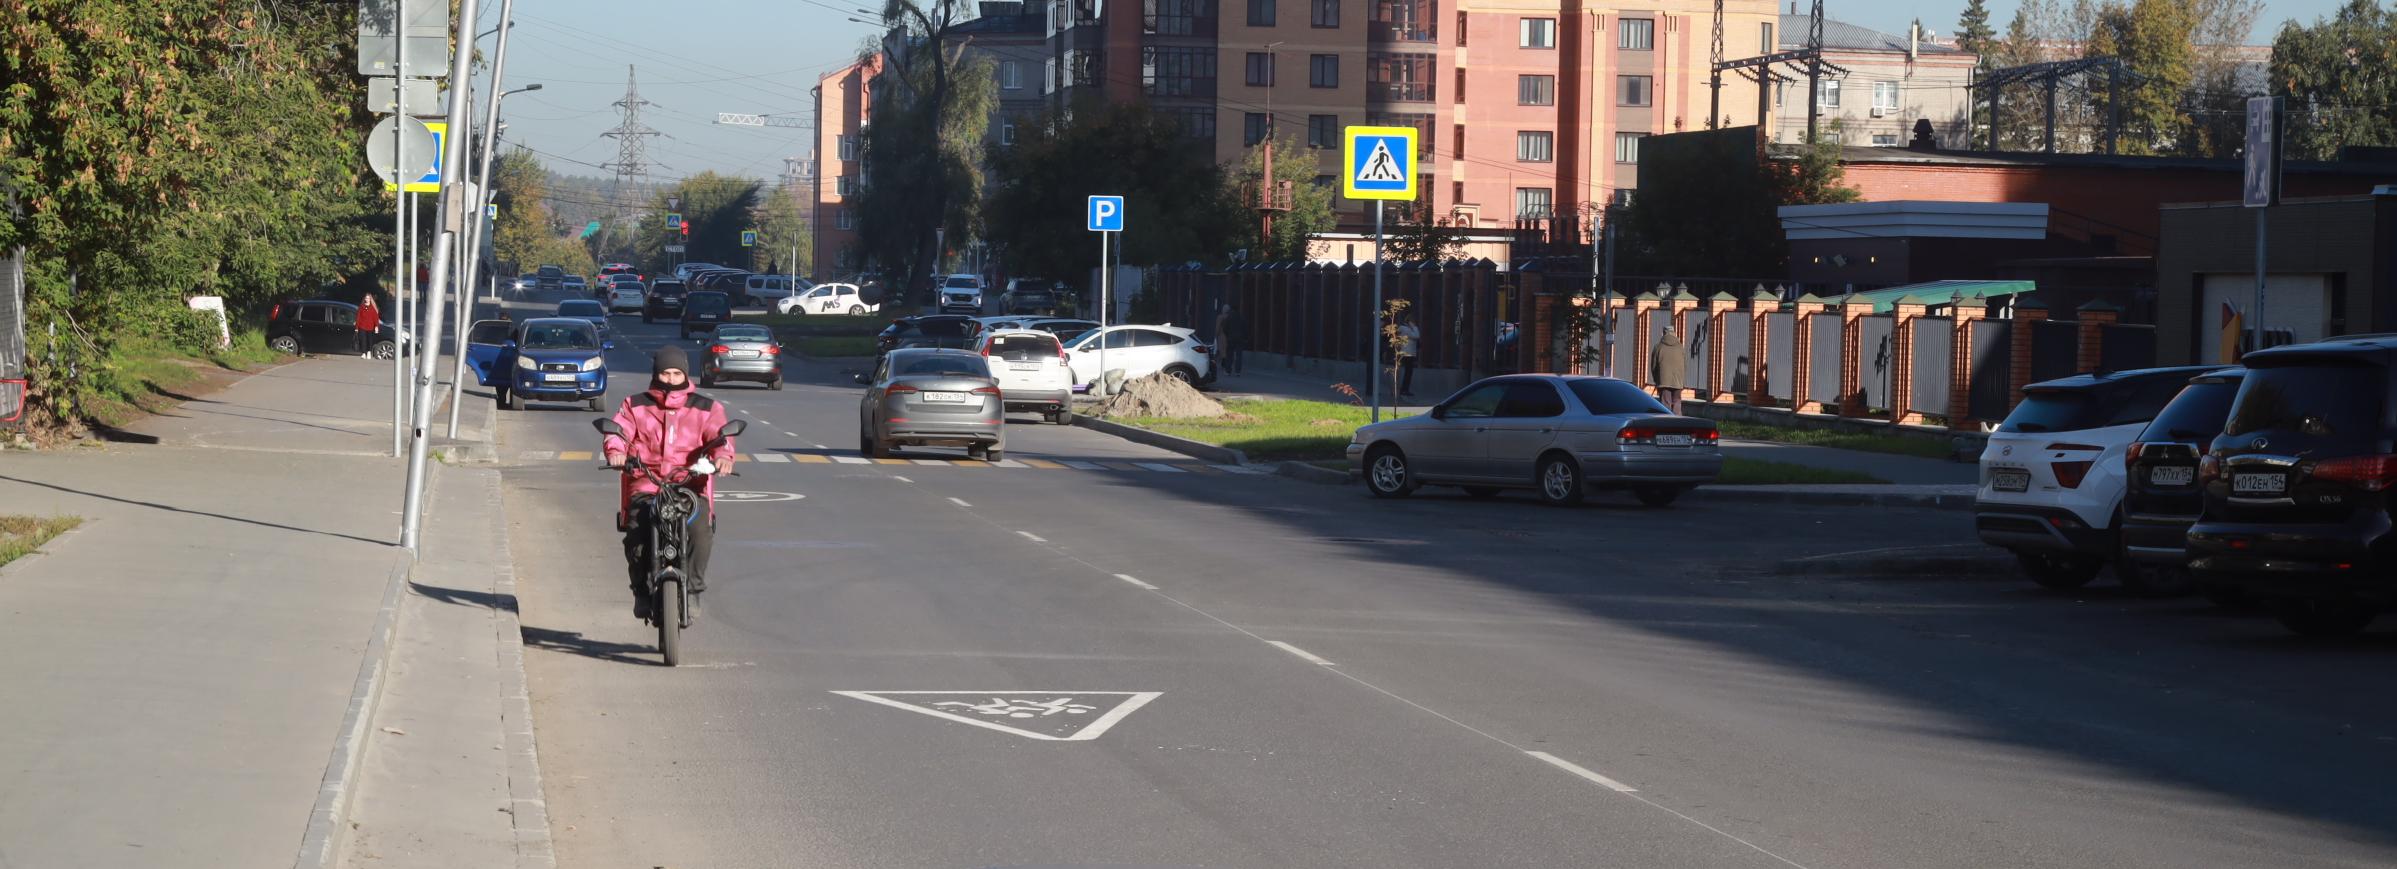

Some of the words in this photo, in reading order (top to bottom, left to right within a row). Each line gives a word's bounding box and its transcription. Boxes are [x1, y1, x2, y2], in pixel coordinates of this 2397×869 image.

[1096, 201, 1115, 226] P
[2236, 475, 2268, 489] К012ЕН
[2271, 474, 2284, 487] 154
